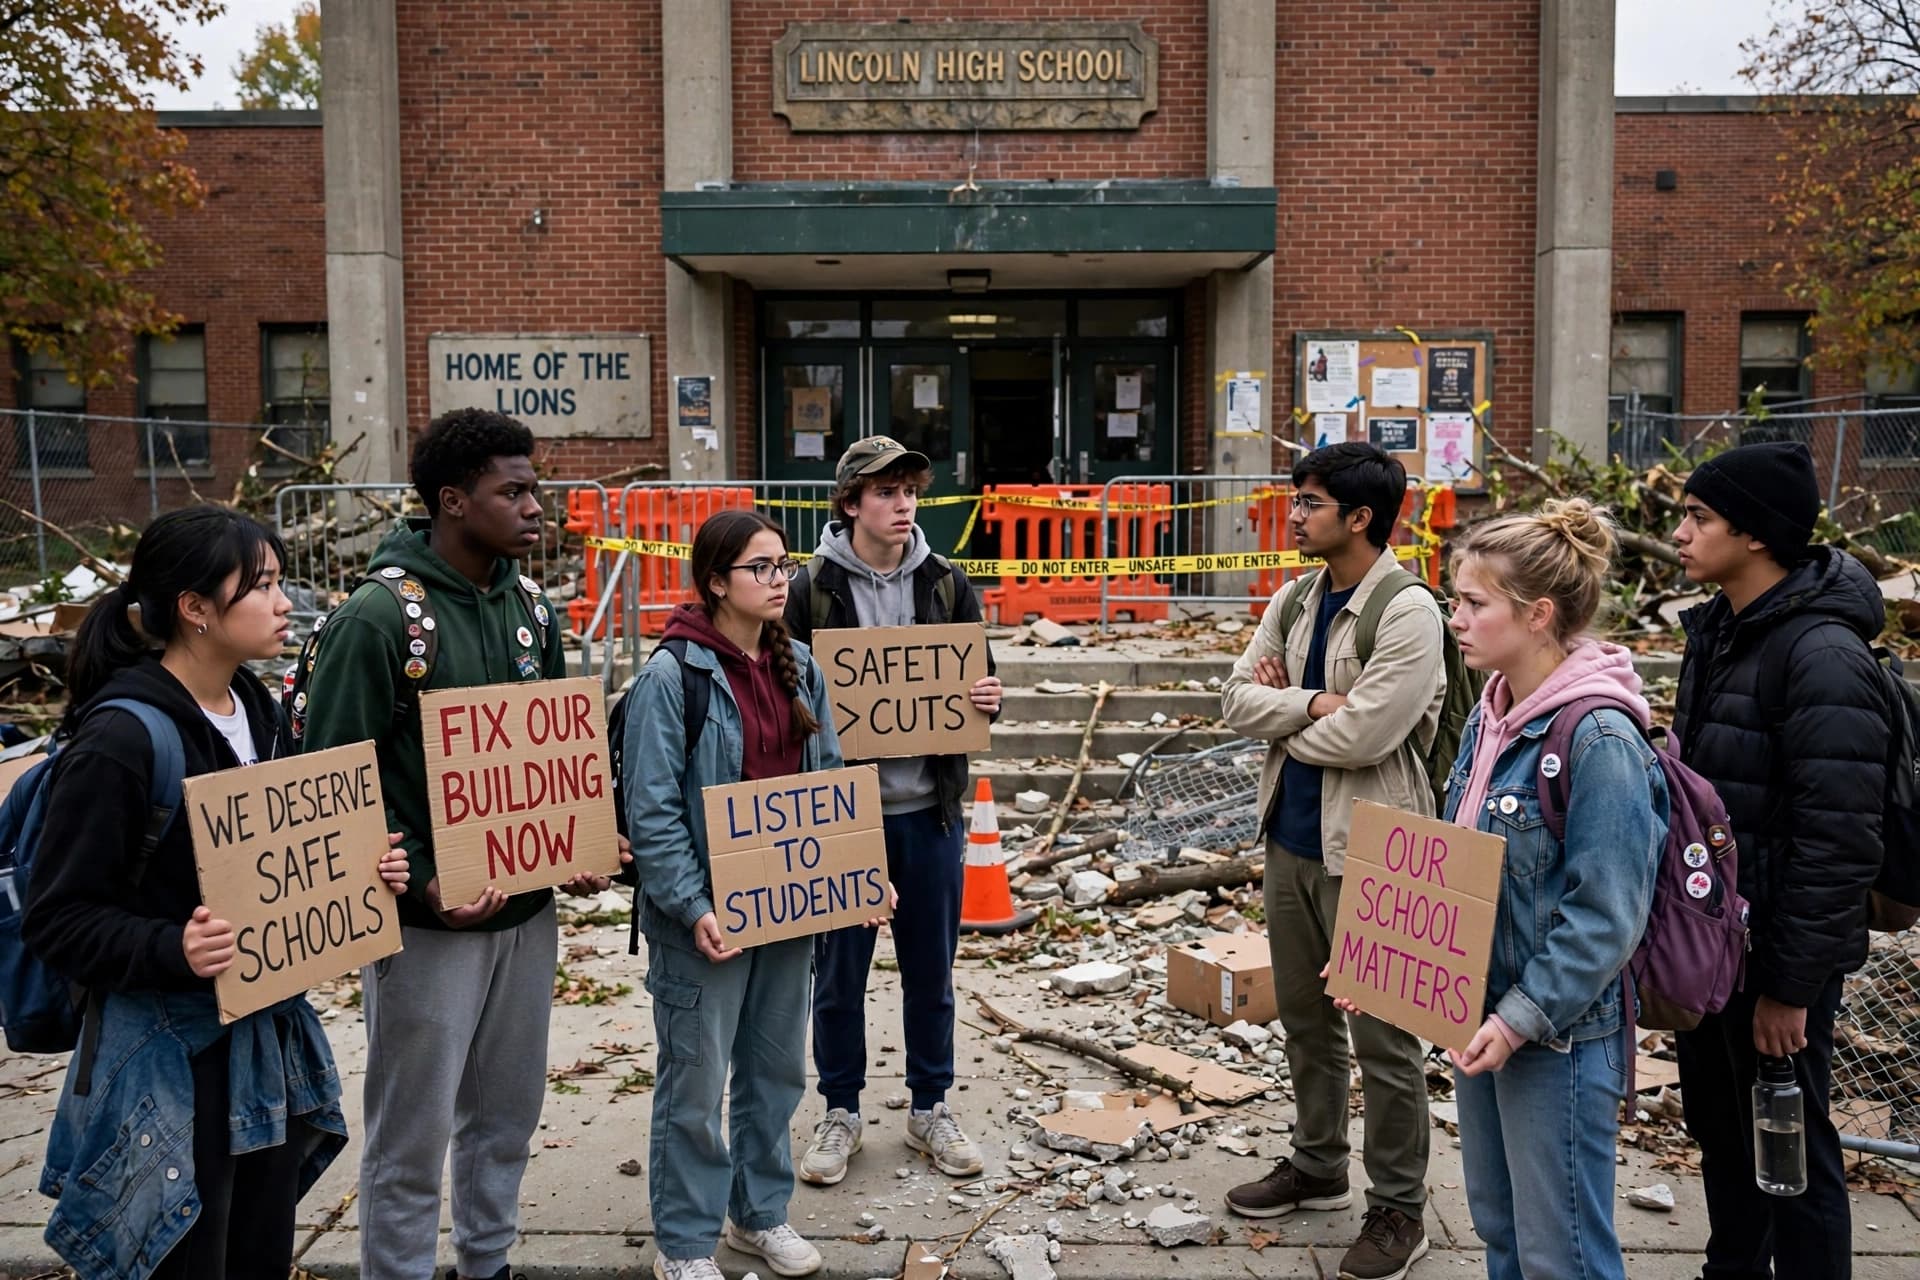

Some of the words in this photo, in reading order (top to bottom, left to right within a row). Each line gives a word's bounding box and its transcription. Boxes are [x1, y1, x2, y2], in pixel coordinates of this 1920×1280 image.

[799, 49, 921, 84] LINCOLN
[936, 49, 1005, 82] HIGH
[1018, 49, 1131, 82] SCHOOL
[446, 353, 522, 381] HOME
[533, 352, 568, 380] OF
[578, 352, 631, 380] THE
[497, 388, 577, 416] LIONS
[623, 540, 638, 551] DO
[641, 543, 663, 553] NOT
[666, 545, 693, 558] ENTE
[1022, 562, 1038, 574] DO
[1042, 561, 1067, 574] NOT
[1071, 560, 1109, 573] ENTER
[1129, 559, 1176, 572] UNSAFE
[1196, 557, 1213, 570] DO
[1216, 556, 1239, 569] NOT
[1243, 554, 1280, 568] ENTER
[833, 642, 973, 687] SAFETY
[439, 700, 513, 757] FIX
[526, 693, 596, 746] OUR
[200, 792, 255, 848] WE
[265, 764, 377, 834] DESERVE
[441, 752, 603, 825] BUILDING
[727, 781, 856, 839] LISTEN
[256, 831, 346, 904] SAFE
[485, 815, 576, 880] NOW
[774, 836, 821, 873] TO
[1385, 827, 1448, 888] OUR
[725, 867, 885, 933] STUDENTS
[1356, 877, 1467, 956] SCHOOL
[236, 886, 384, 983] SCHOOLS
[1339, 930, 1471, 1025] MATTERS
